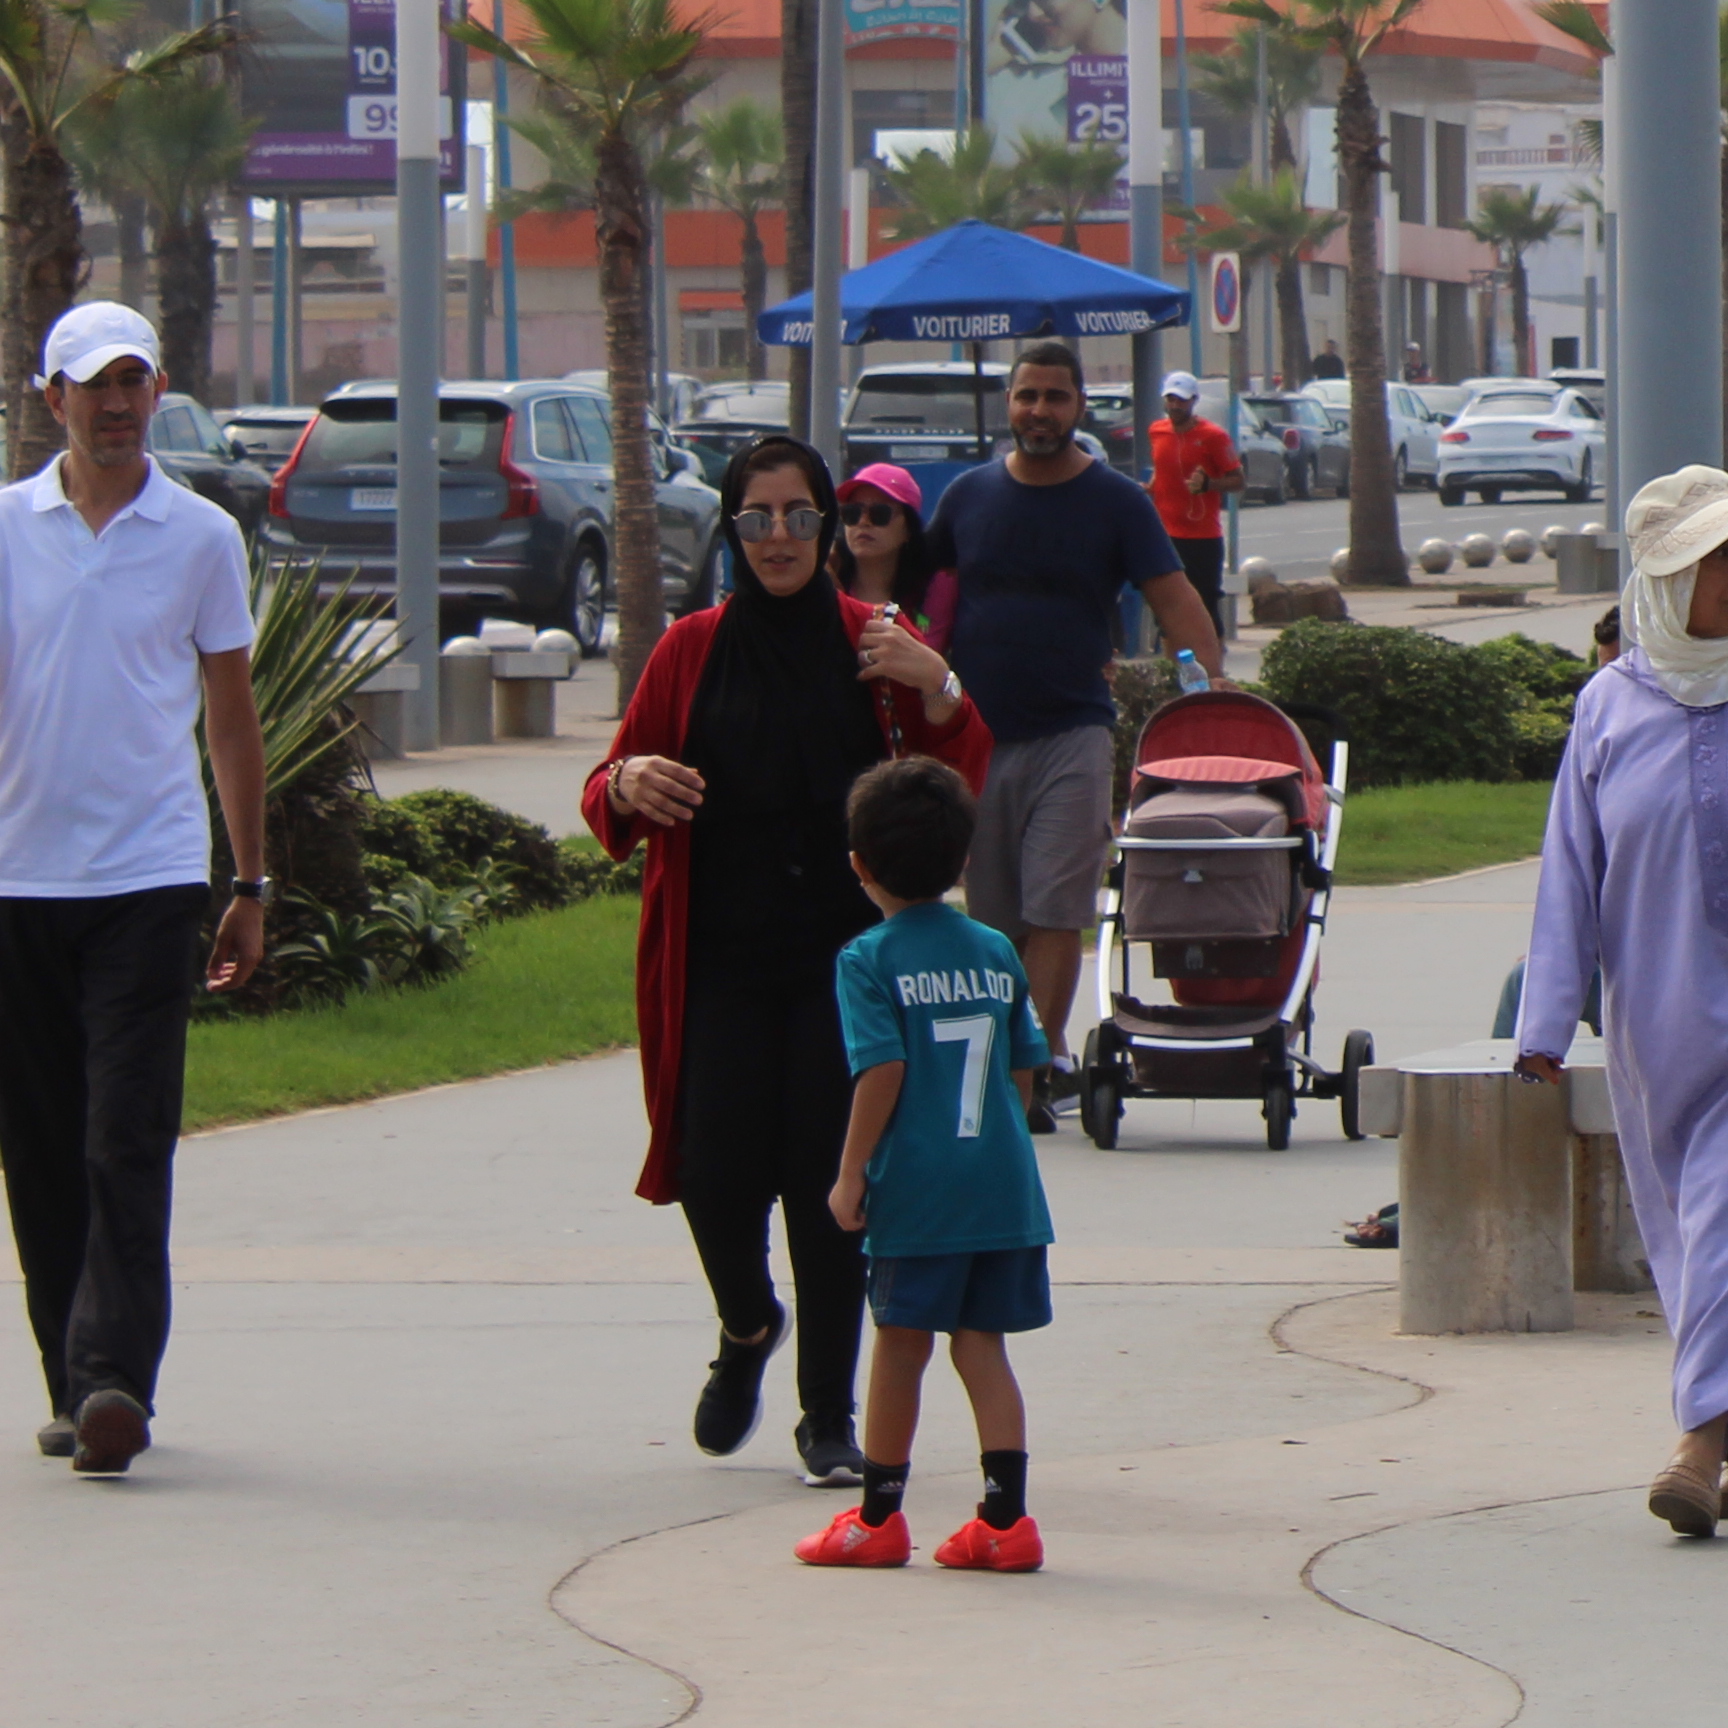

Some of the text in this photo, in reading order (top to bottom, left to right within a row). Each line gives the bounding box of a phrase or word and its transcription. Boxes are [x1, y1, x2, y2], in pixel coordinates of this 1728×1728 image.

[914, 314, 1011, 338] VOITURIER
[1074, 310, 1157, 333] VOITURIER
[896, 968, 1014, 1006] RONALDO
[932, 1013, 996, 1138] 7
